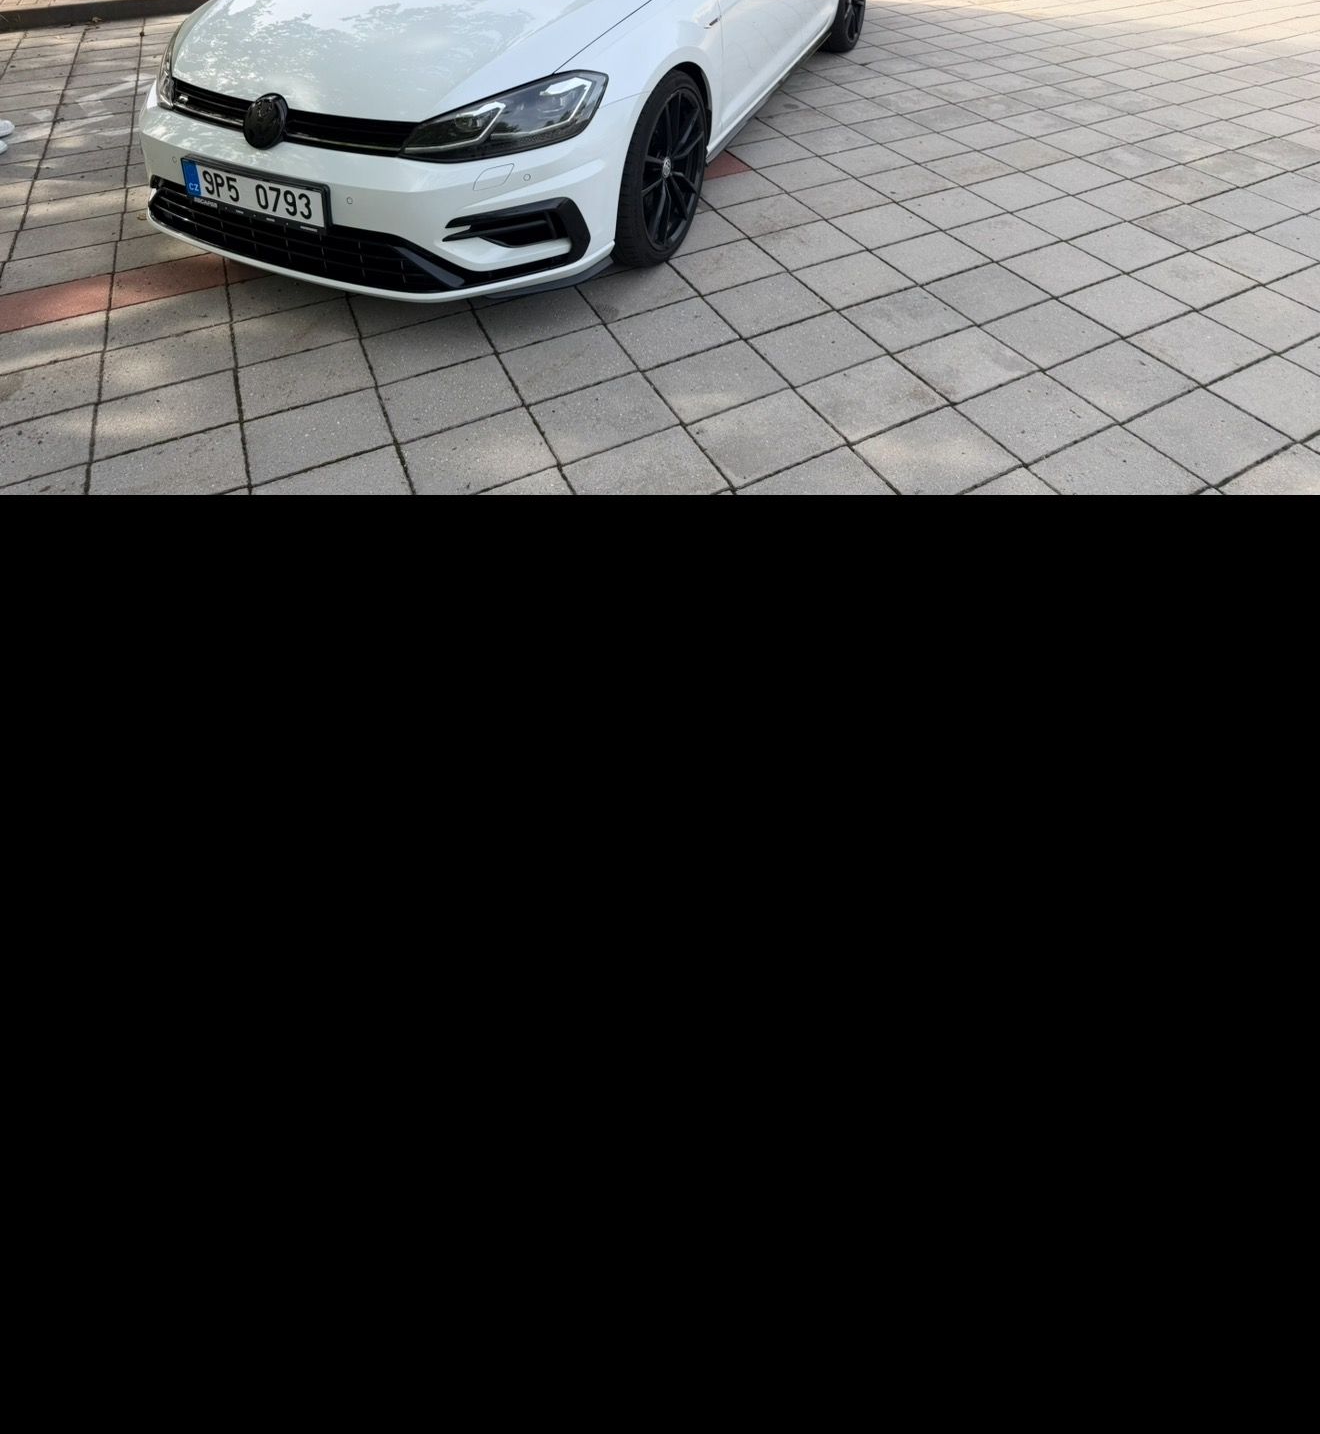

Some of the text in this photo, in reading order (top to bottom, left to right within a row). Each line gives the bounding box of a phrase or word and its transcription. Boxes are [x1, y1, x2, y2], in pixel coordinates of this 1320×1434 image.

[188, 182, 199, 192] CZ
[202, 170, 312, 220] 9P5 0793
